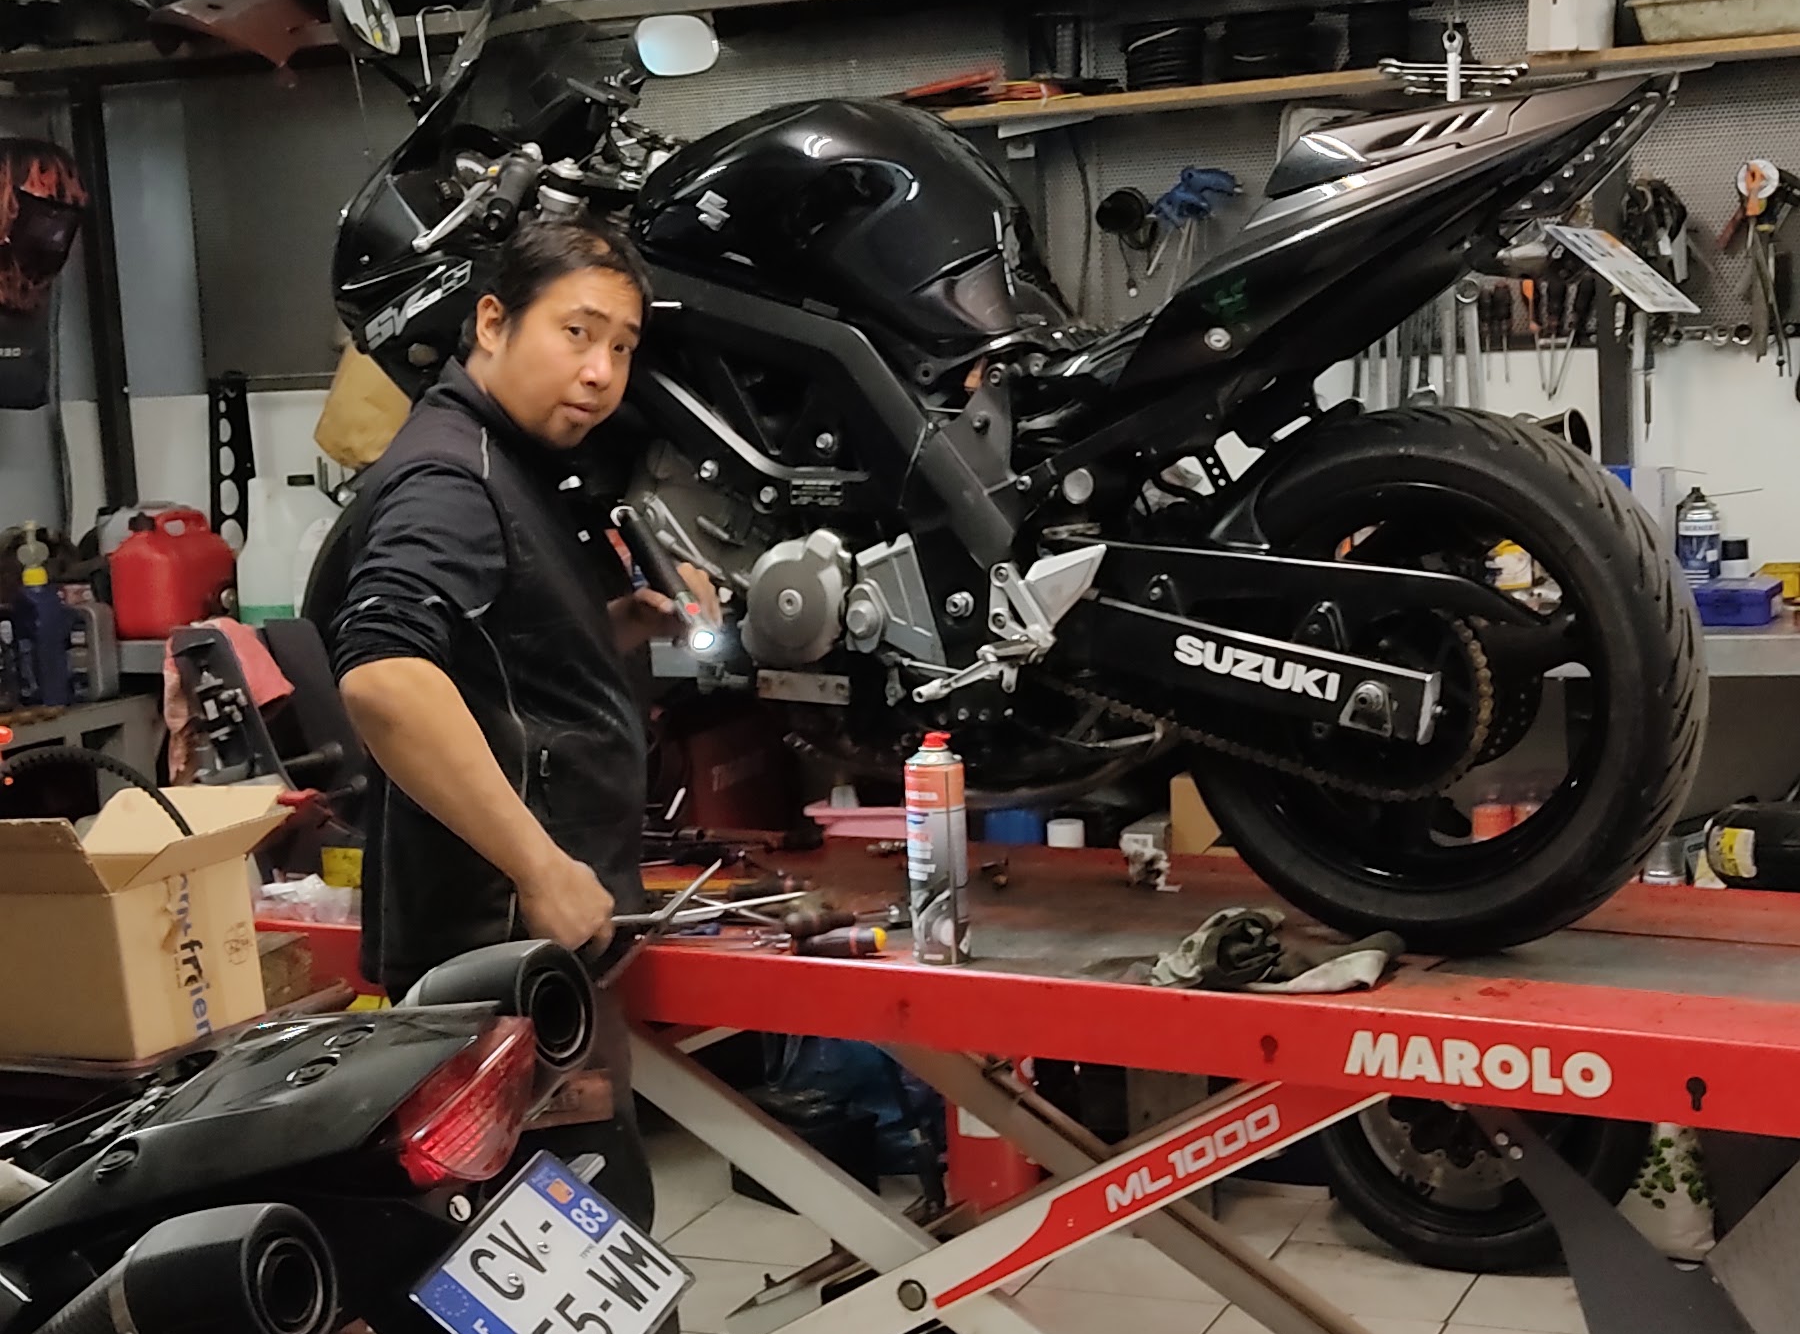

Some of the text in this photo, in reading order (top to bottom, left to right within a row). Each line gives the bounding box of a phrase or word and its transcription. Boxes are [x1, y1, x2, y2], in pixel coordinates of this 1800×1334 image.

[1174, 635, 1340, 701] SUZUKI
[1344, 1030, 1612, 1098] MAROLO
[1105, 1103, 1280, 1213] ML1000
[570, 1197, 608, 1233] 83
